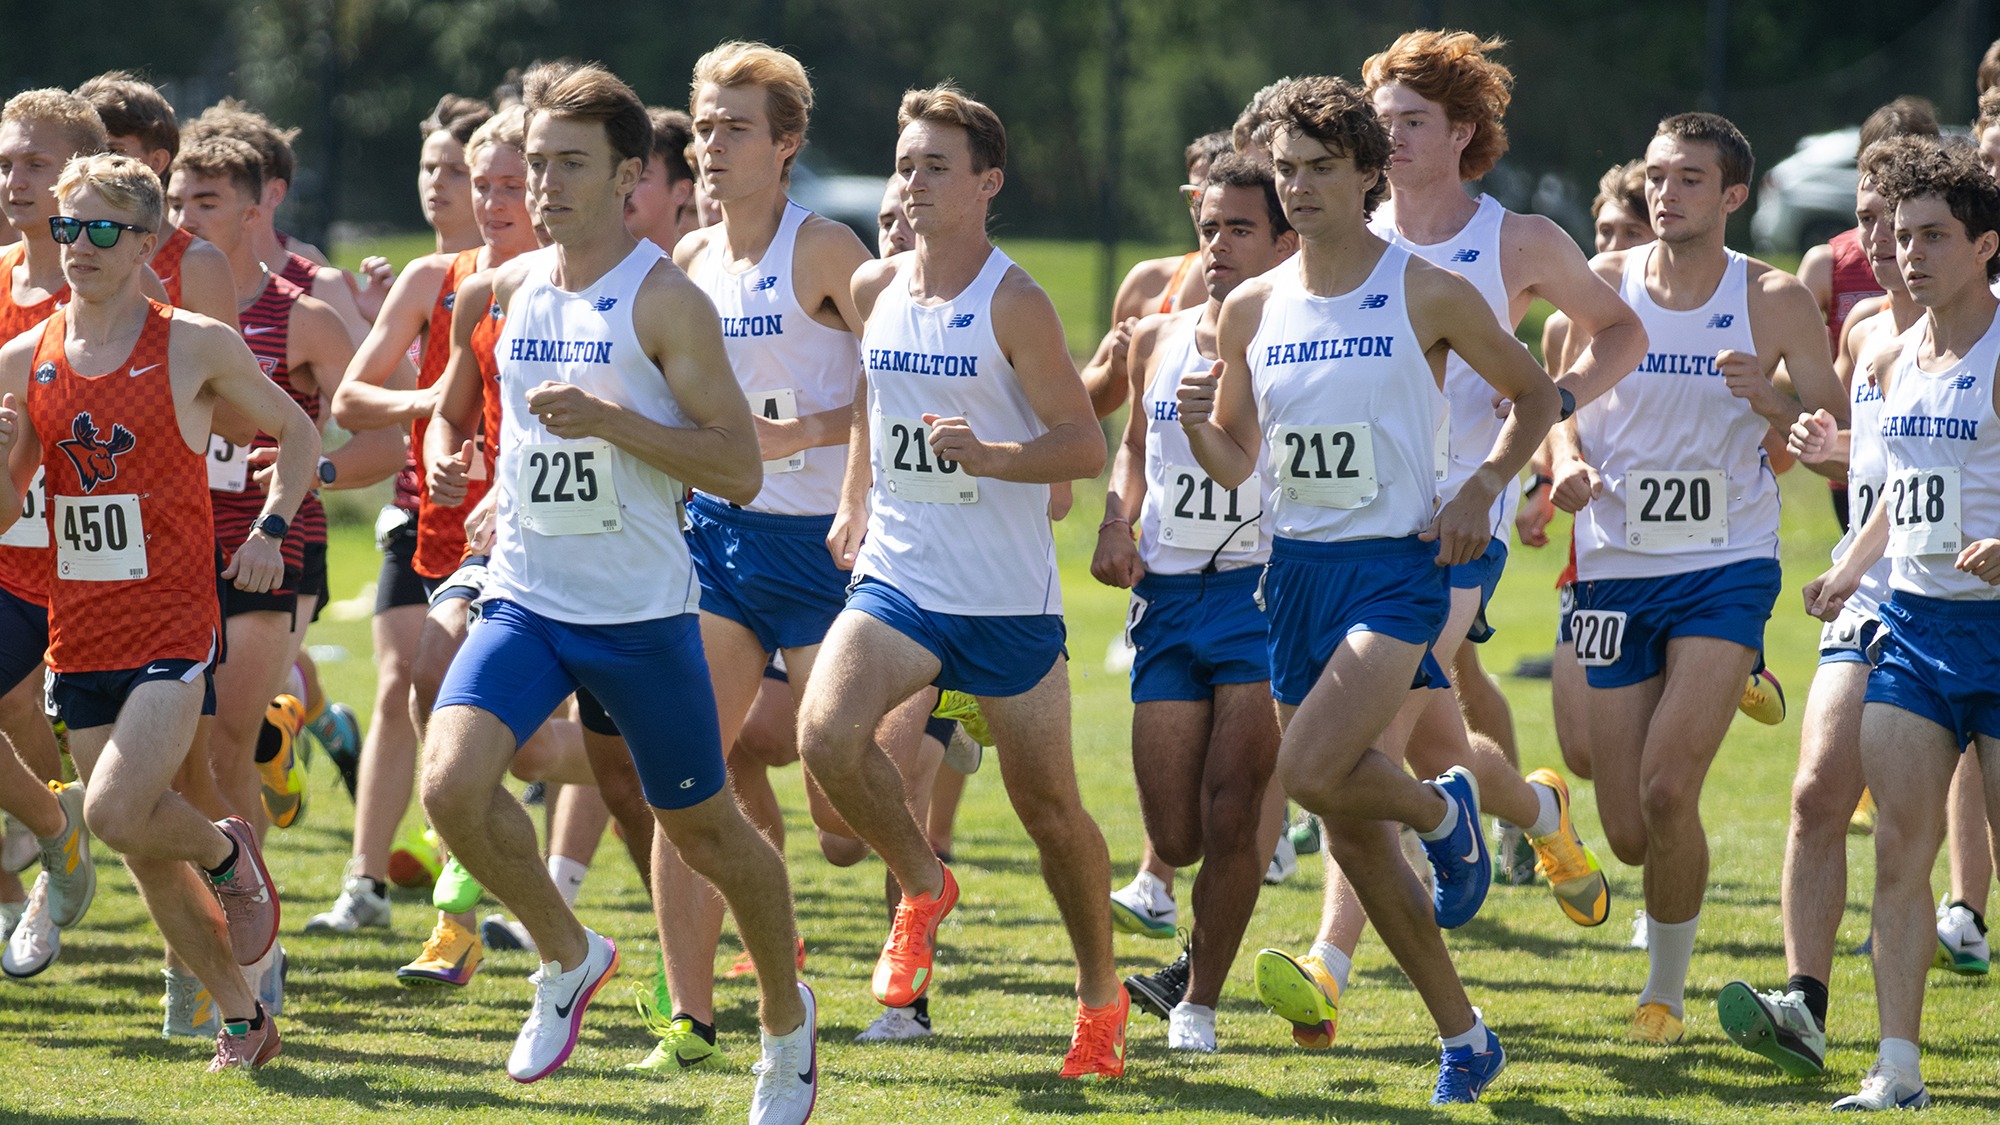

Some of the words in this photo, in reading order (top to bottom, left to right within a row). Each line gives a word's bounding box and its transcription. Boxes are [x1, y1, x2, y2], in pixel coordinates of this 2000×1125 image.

[720, 314, 783, 338] ILTON
[510, 338, 613, 364] HAMILTON
[869, 348, 978, 377] HAMILTON
[1266, 336, 1394, 367] HAMILTON
[1632, 353, 1726, 377] MILTO
[1882, 415, 1978, 441] HAMILTON
[530, 451, 598, 503] 225
[1285, 431, 1360, 479] 212
[1174, 473, 1242, 522] 211
[1640, 477, 1711, 522] 220
[1893, 474, 1945, 526] 218
[64, 503, 128, 552] 450
[1572, 615, 1620, 660] 220
